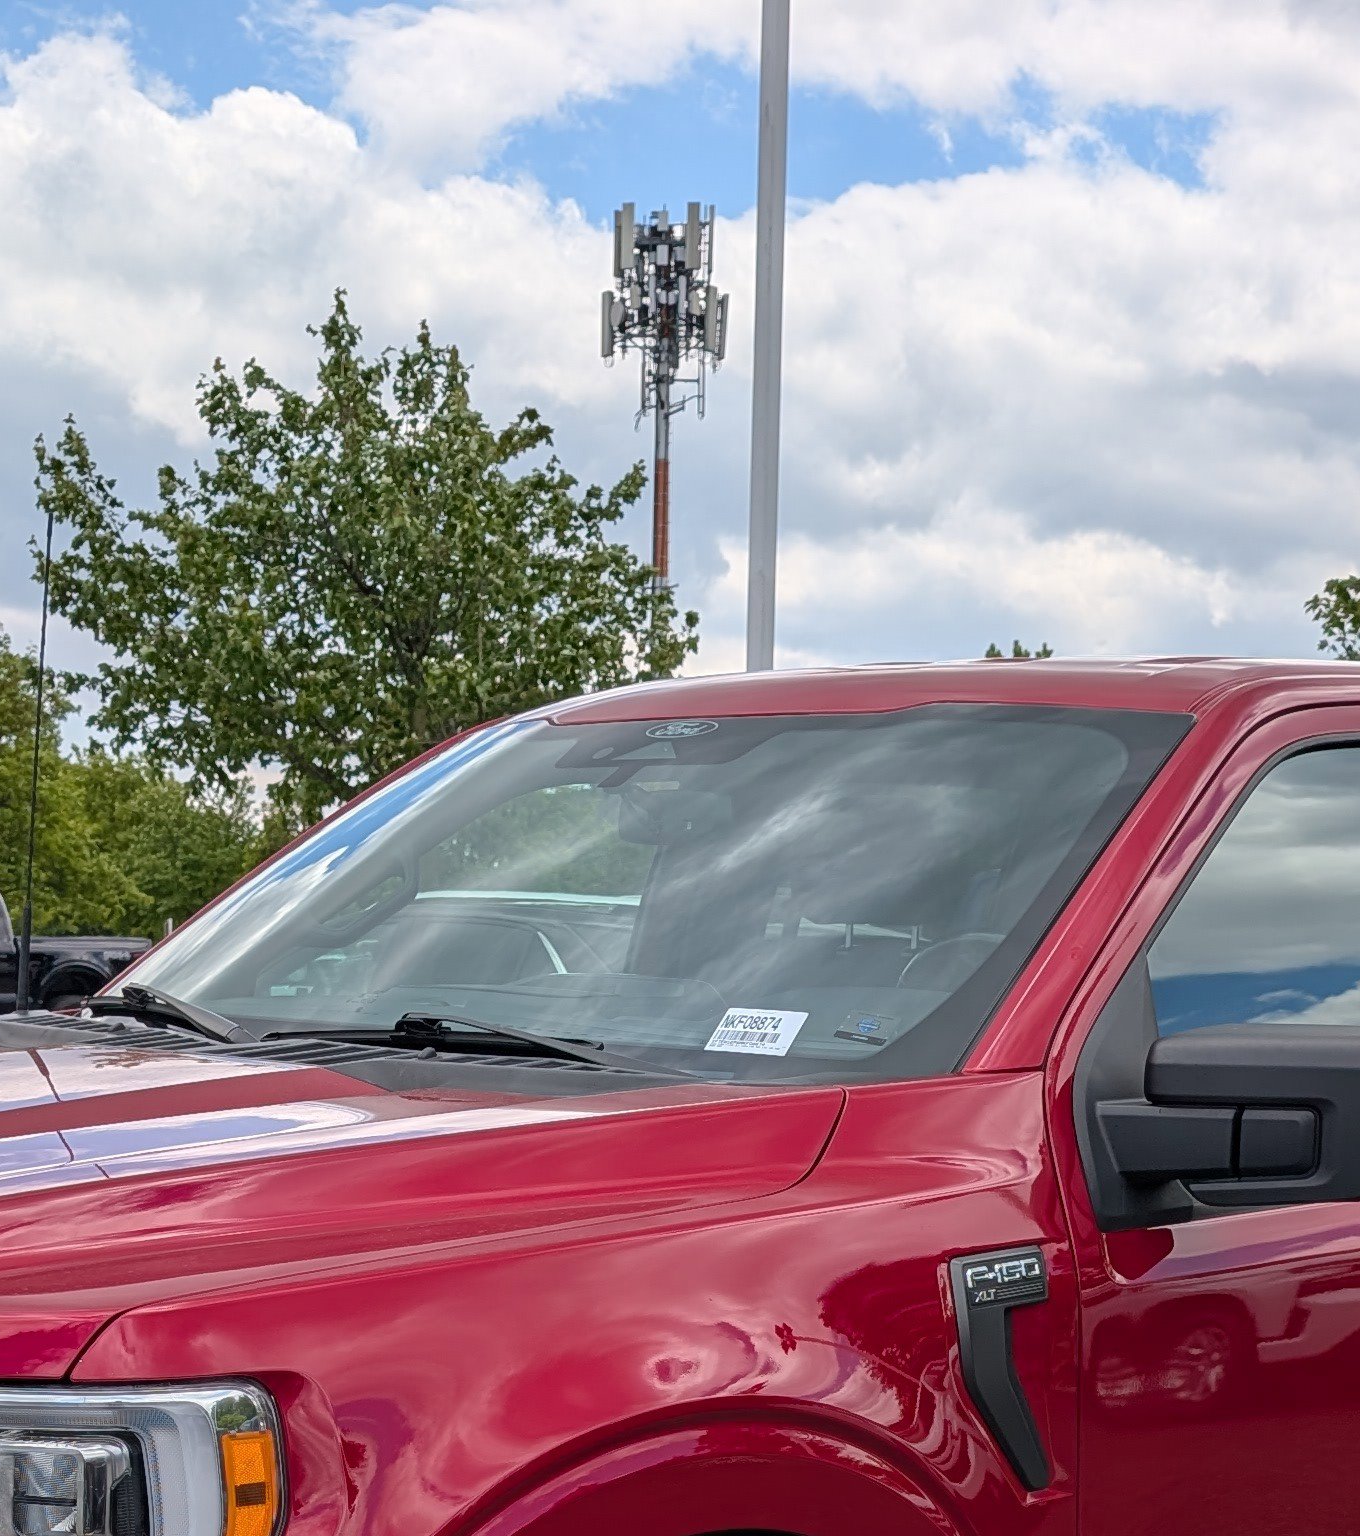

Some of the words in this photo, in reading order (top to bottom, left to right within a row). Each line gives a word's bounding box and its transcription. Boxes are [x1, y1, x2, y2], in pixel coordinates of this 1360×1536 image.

[654, 721, 708, 736] Ford
[721, 1014, 783, 1031] NKF08874
[965, 1257, 1041, 1288] F-150
[974, 1288, 996, 1303] XLT
